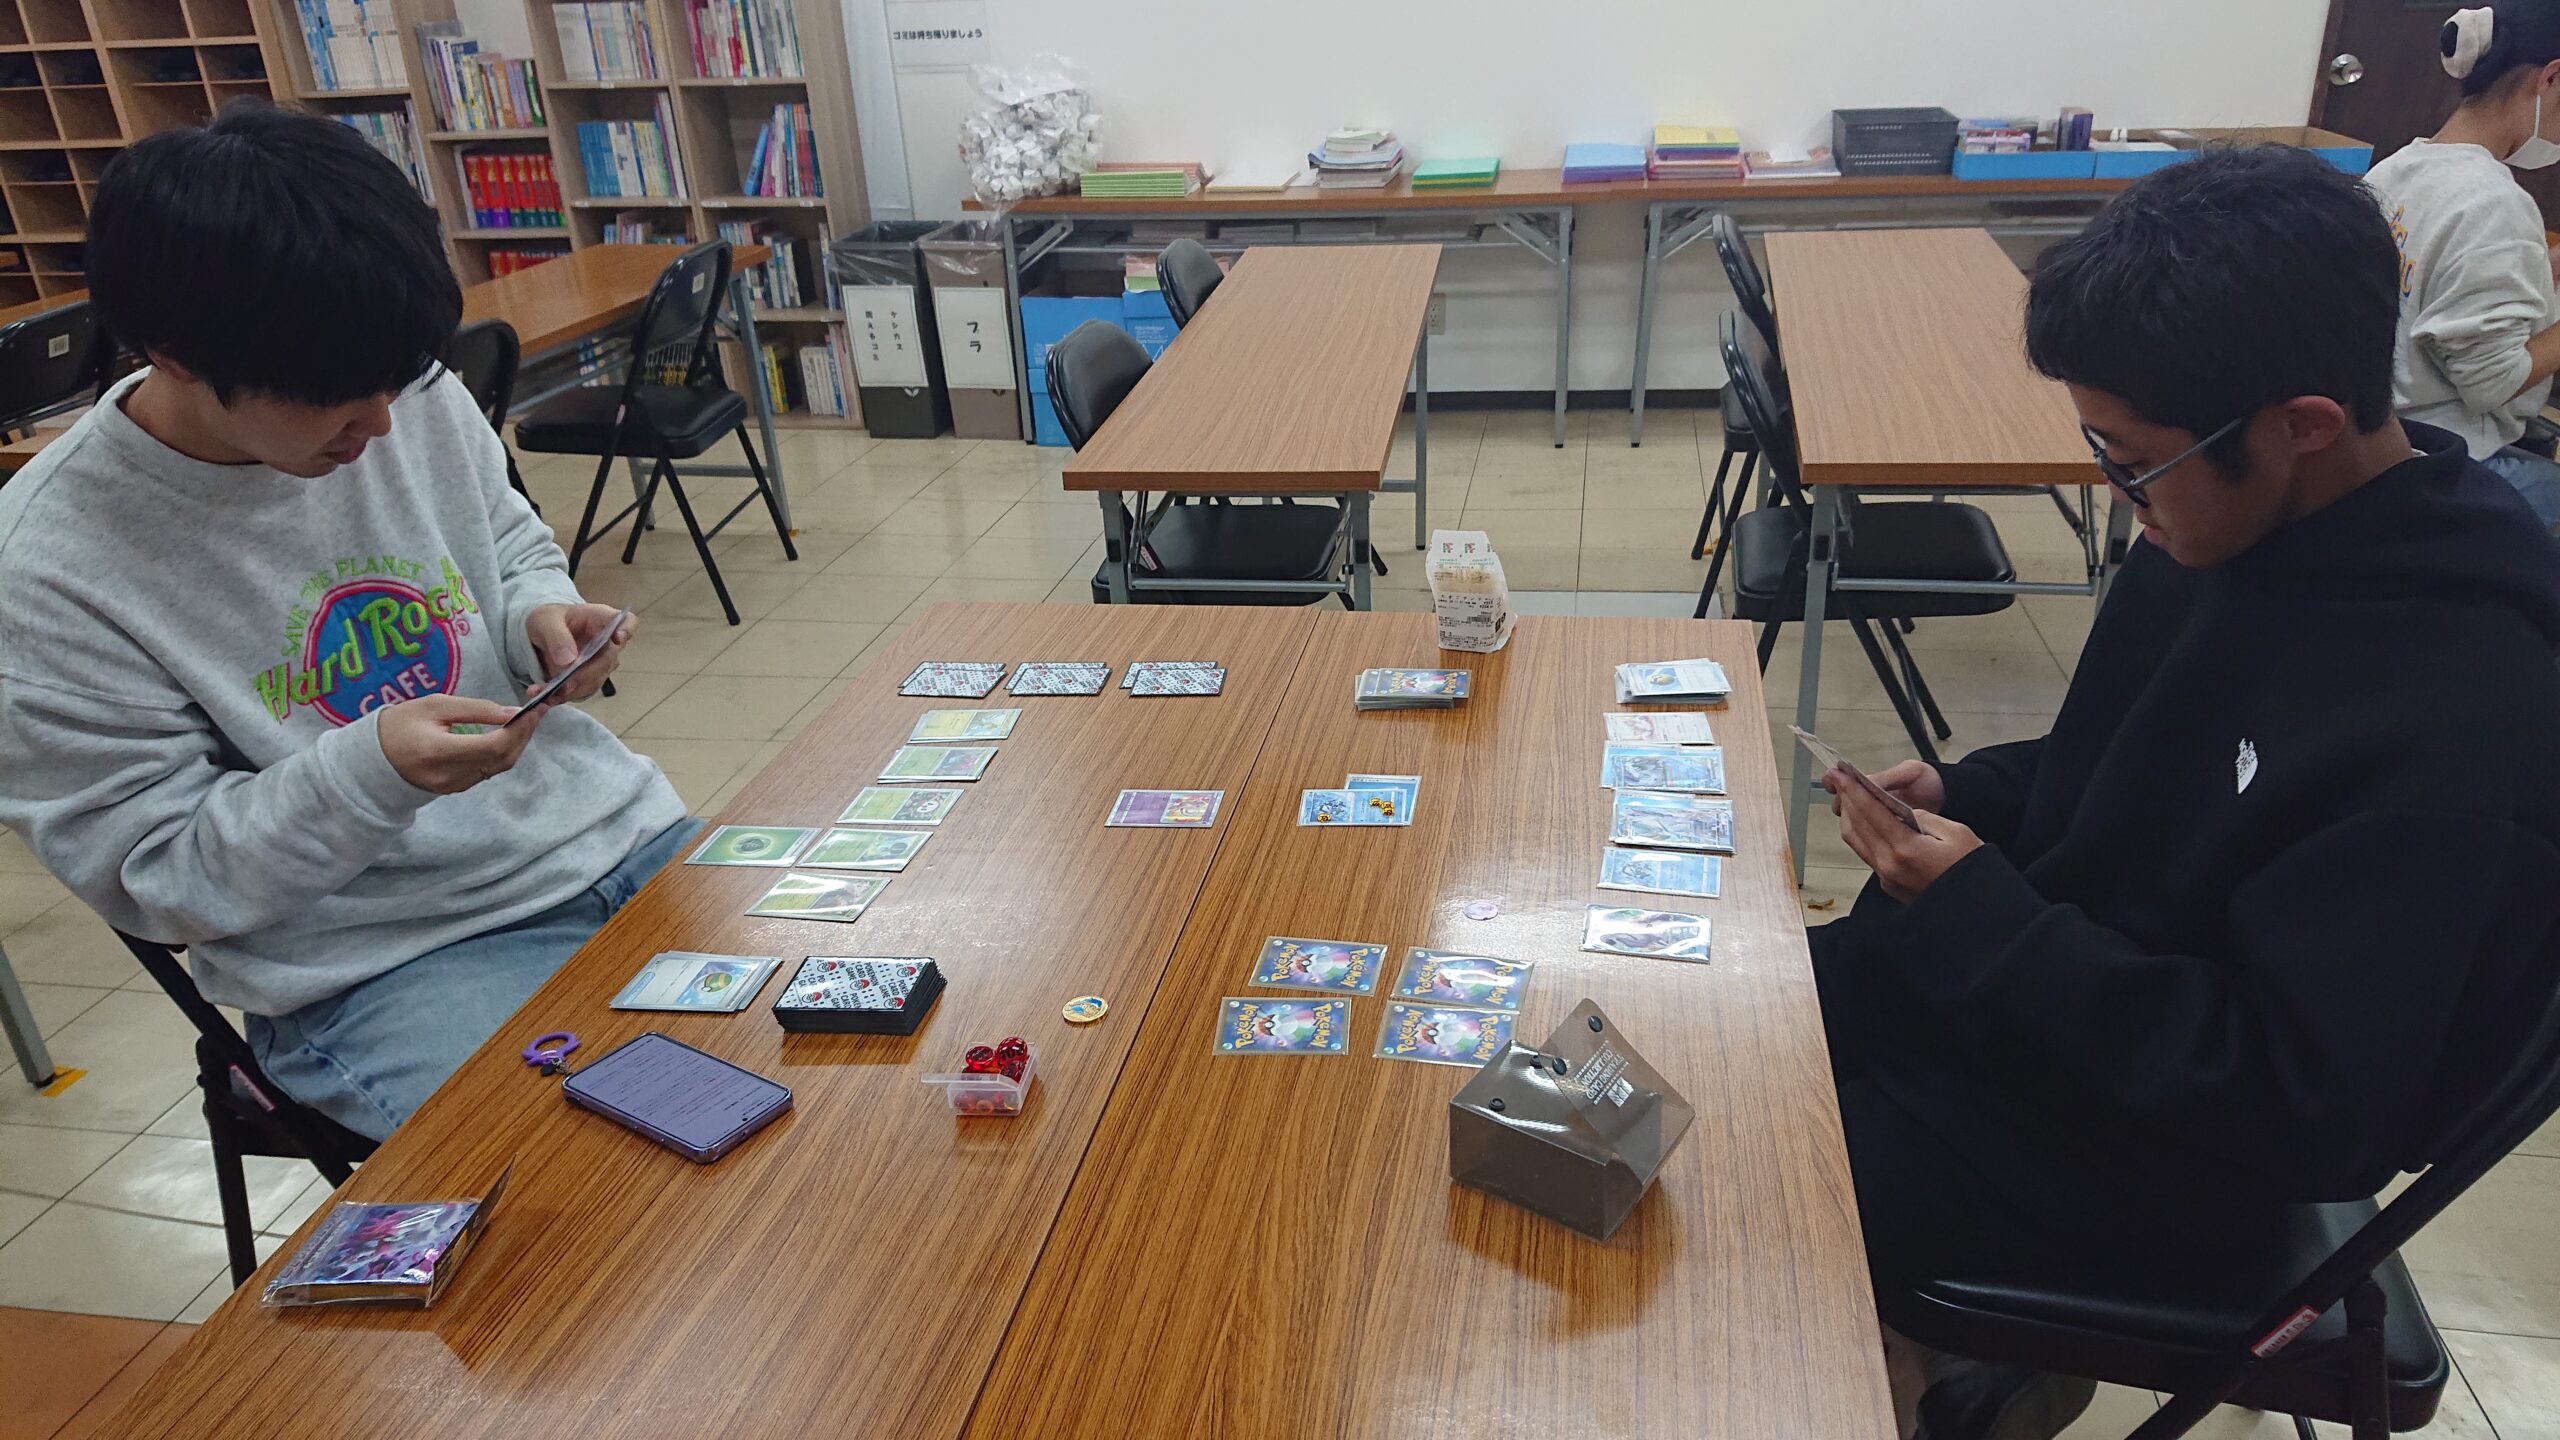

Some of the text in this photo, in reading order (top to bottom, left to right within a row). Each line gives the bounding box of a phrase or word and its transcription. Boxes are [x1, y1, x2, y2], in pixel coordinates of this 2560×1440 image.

[336, 555, 425, 580] PLANET
[253, 556, 479, 725] Hard Rock
[358, 662, 438, 717] CAFE
[845, 967, 857, 981] GAME
[855, 964, 866, 978] CARD
[879, 984, 891, 999] GAME
[888, 982, 900, 996] CARD
[1581, 1049, 1613, 1087] COLLECTION
[1586, 1054, 1625, 1099] TRADING CARD
